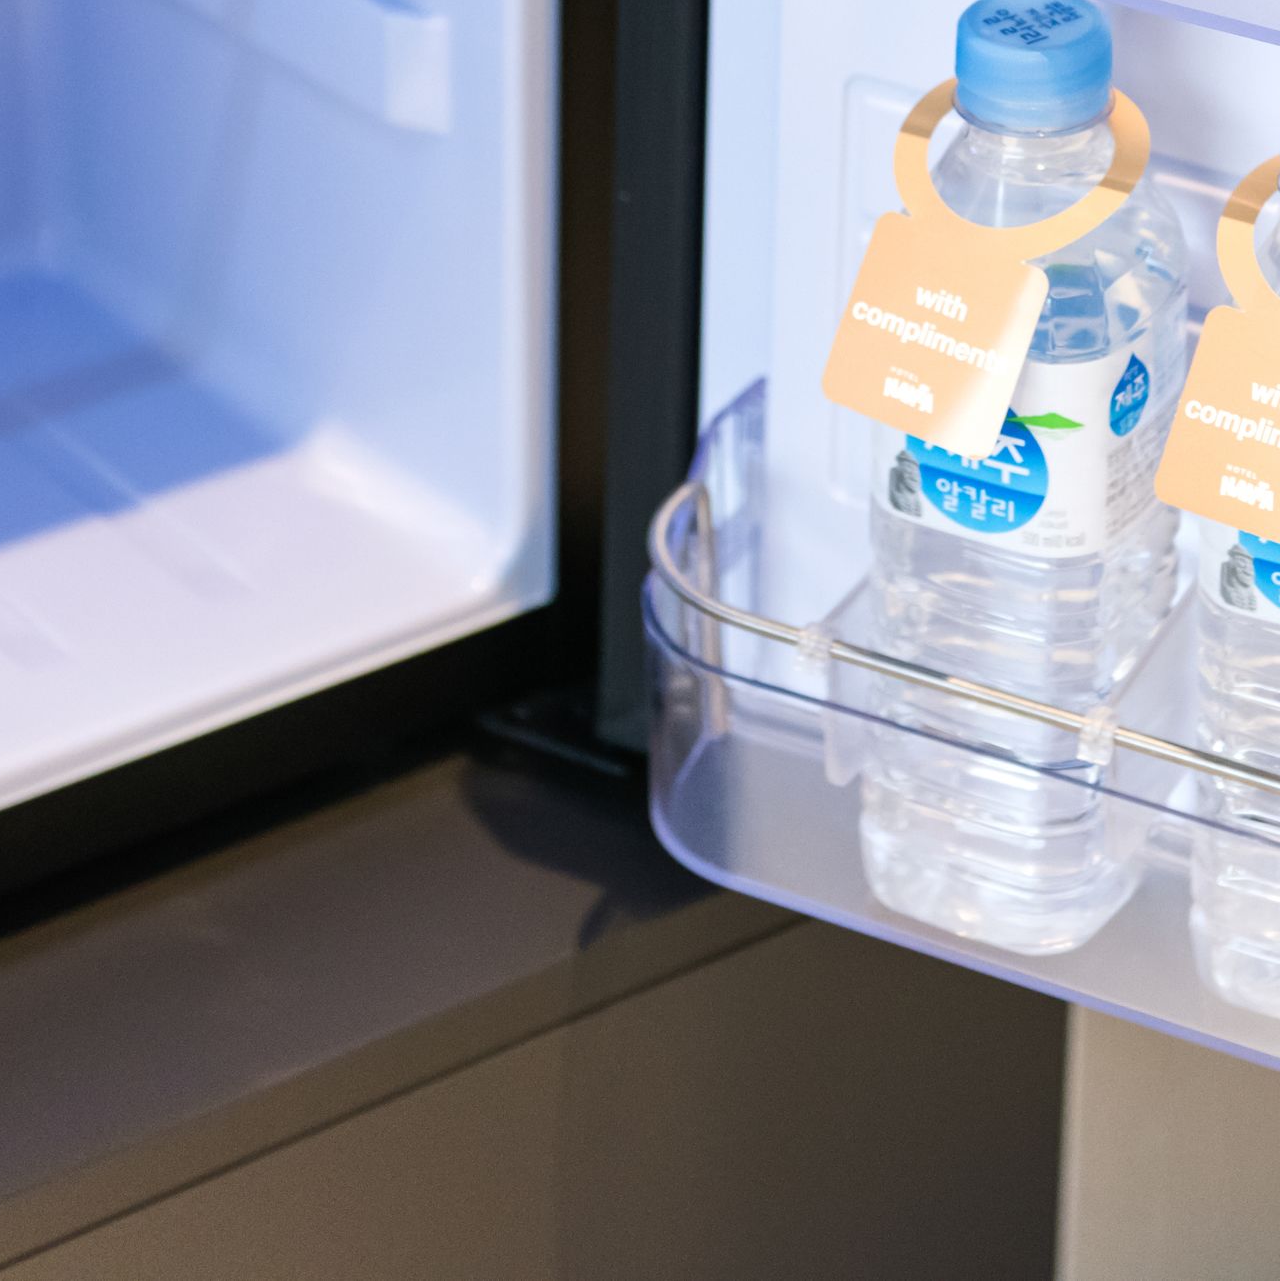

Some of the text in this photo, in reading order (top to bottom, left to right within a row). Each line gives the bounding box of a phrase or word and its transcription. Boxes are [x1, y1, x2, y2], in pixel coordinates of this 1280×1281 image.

[982, 8, 1049, 46] 알칼리
[915, 285, 969, 323] with
[923, 434, 1031, 485] 주
[935, 477, 1016, 524] 알칼리
